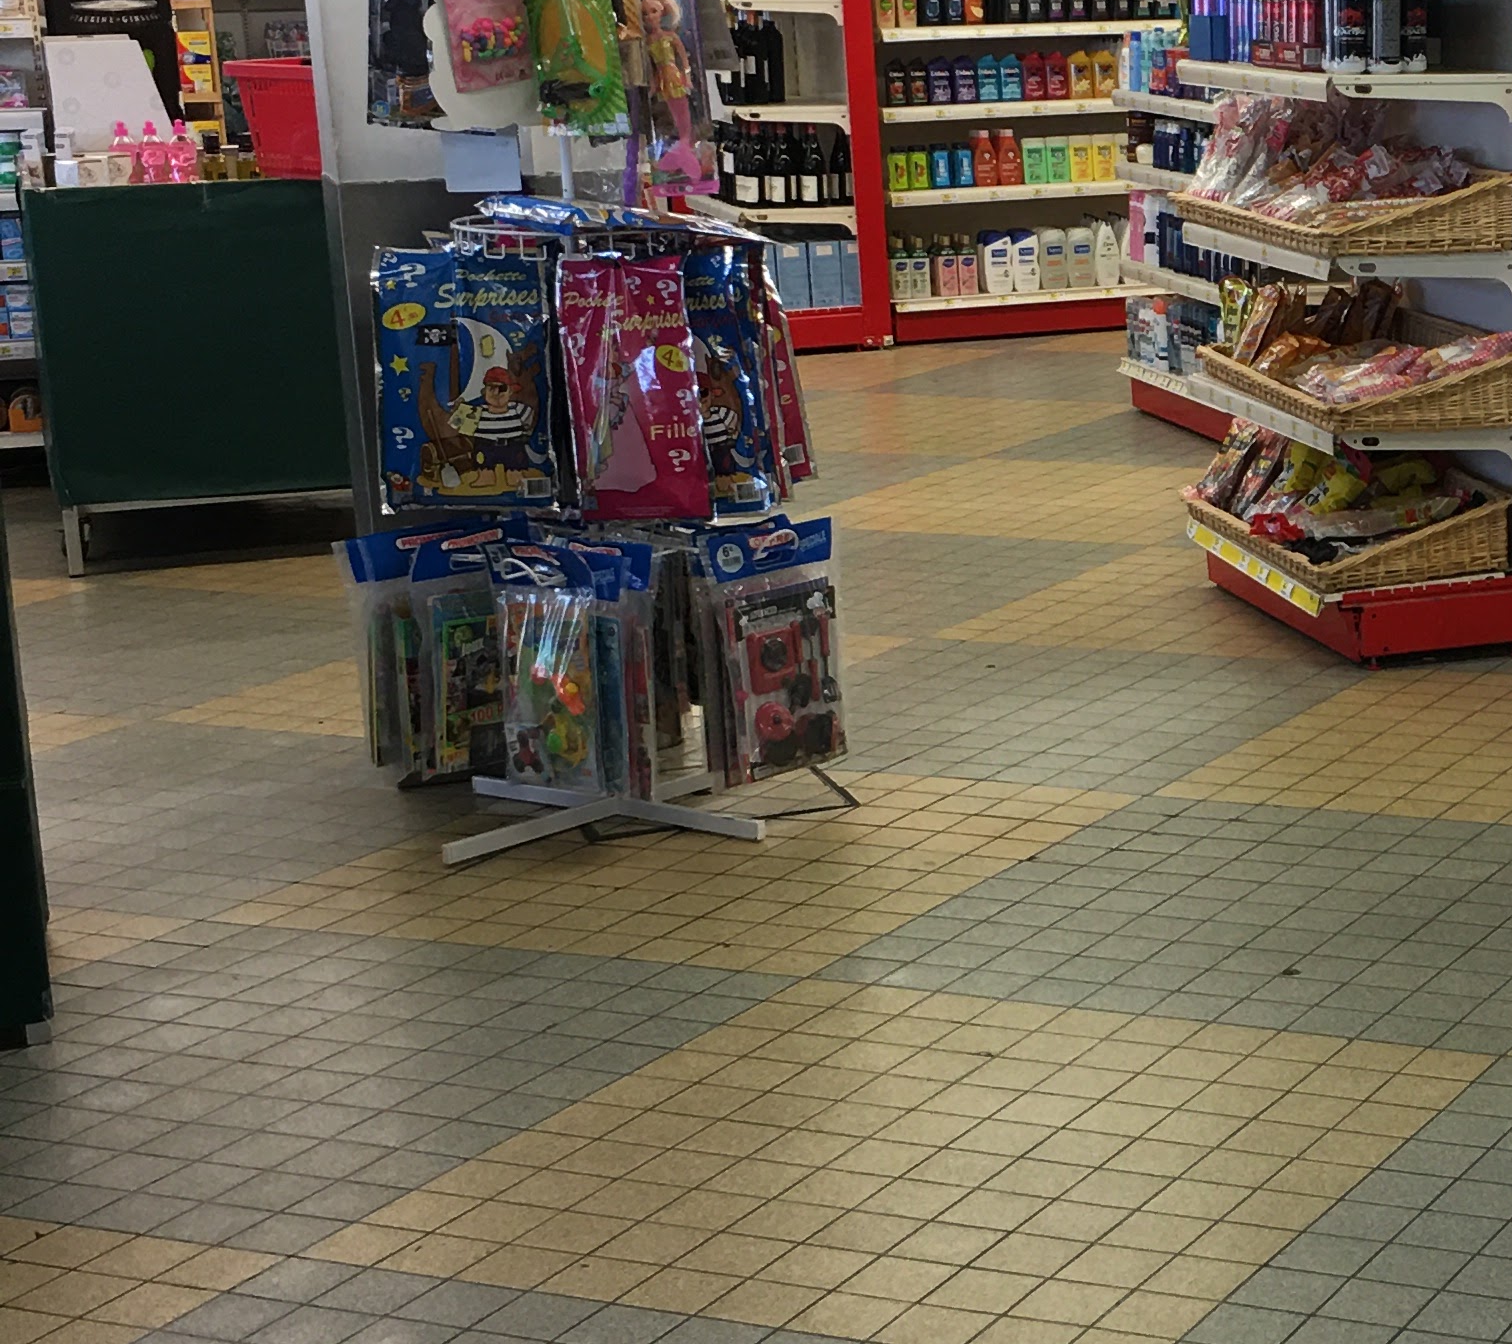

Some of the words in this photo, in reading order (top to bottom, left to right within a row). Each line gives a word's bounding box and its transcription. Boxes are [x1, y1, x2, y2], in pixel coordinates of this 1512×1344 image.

[456, 268, 527, 281] Pochette
[434, 283, 540, 313] Surprises
[684, 293, 728, 311] rises
[610, 309, 686, 337] Surprises
